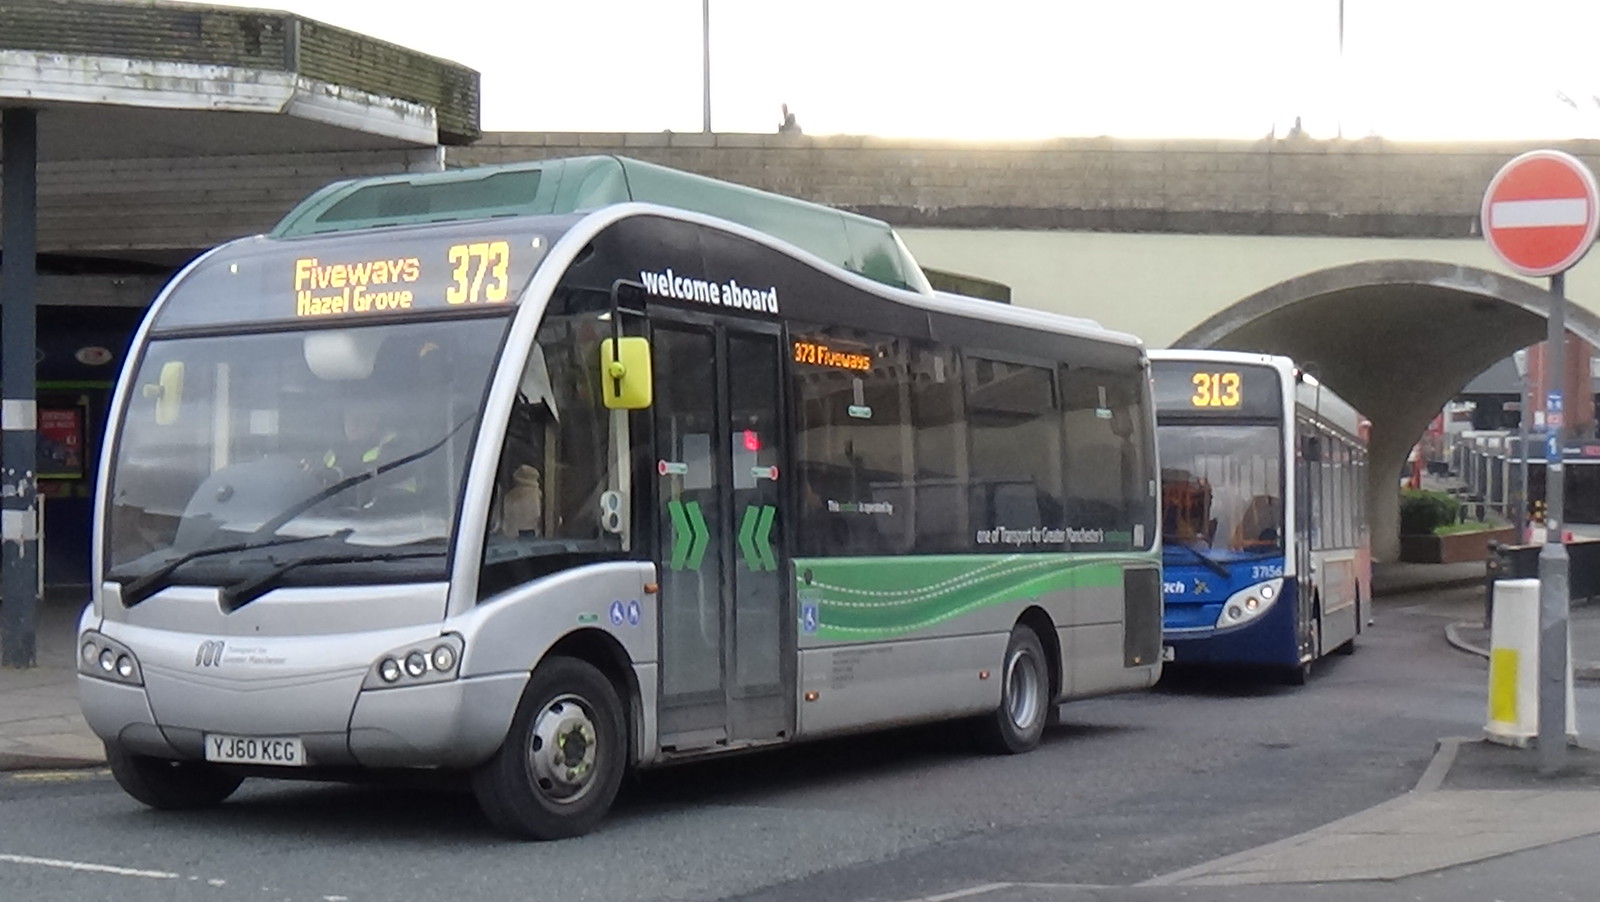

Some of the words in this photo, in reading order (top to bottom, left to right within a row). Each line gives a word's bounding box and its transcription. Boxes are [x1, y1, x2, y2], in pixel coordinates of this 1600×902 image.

[295, 257, 420, 291] Fiveways
[446, 240, 510, 305] 373
[297, 287, 350, 316] Hazel
[353, 285, 414, 312] Grove
[640, 268, 720, 304] welcome
[722, 279, 779, 313] aboard
[794, 342, 815, 364] 373
[817, 345, 871, 370] Fiveways
[1191, 372, 1241, 407] 313
[1000, 526, 1031, 547] Transport
[213, 737, 257, 759] YJ60
[261, 740, 295, 761] KCG
